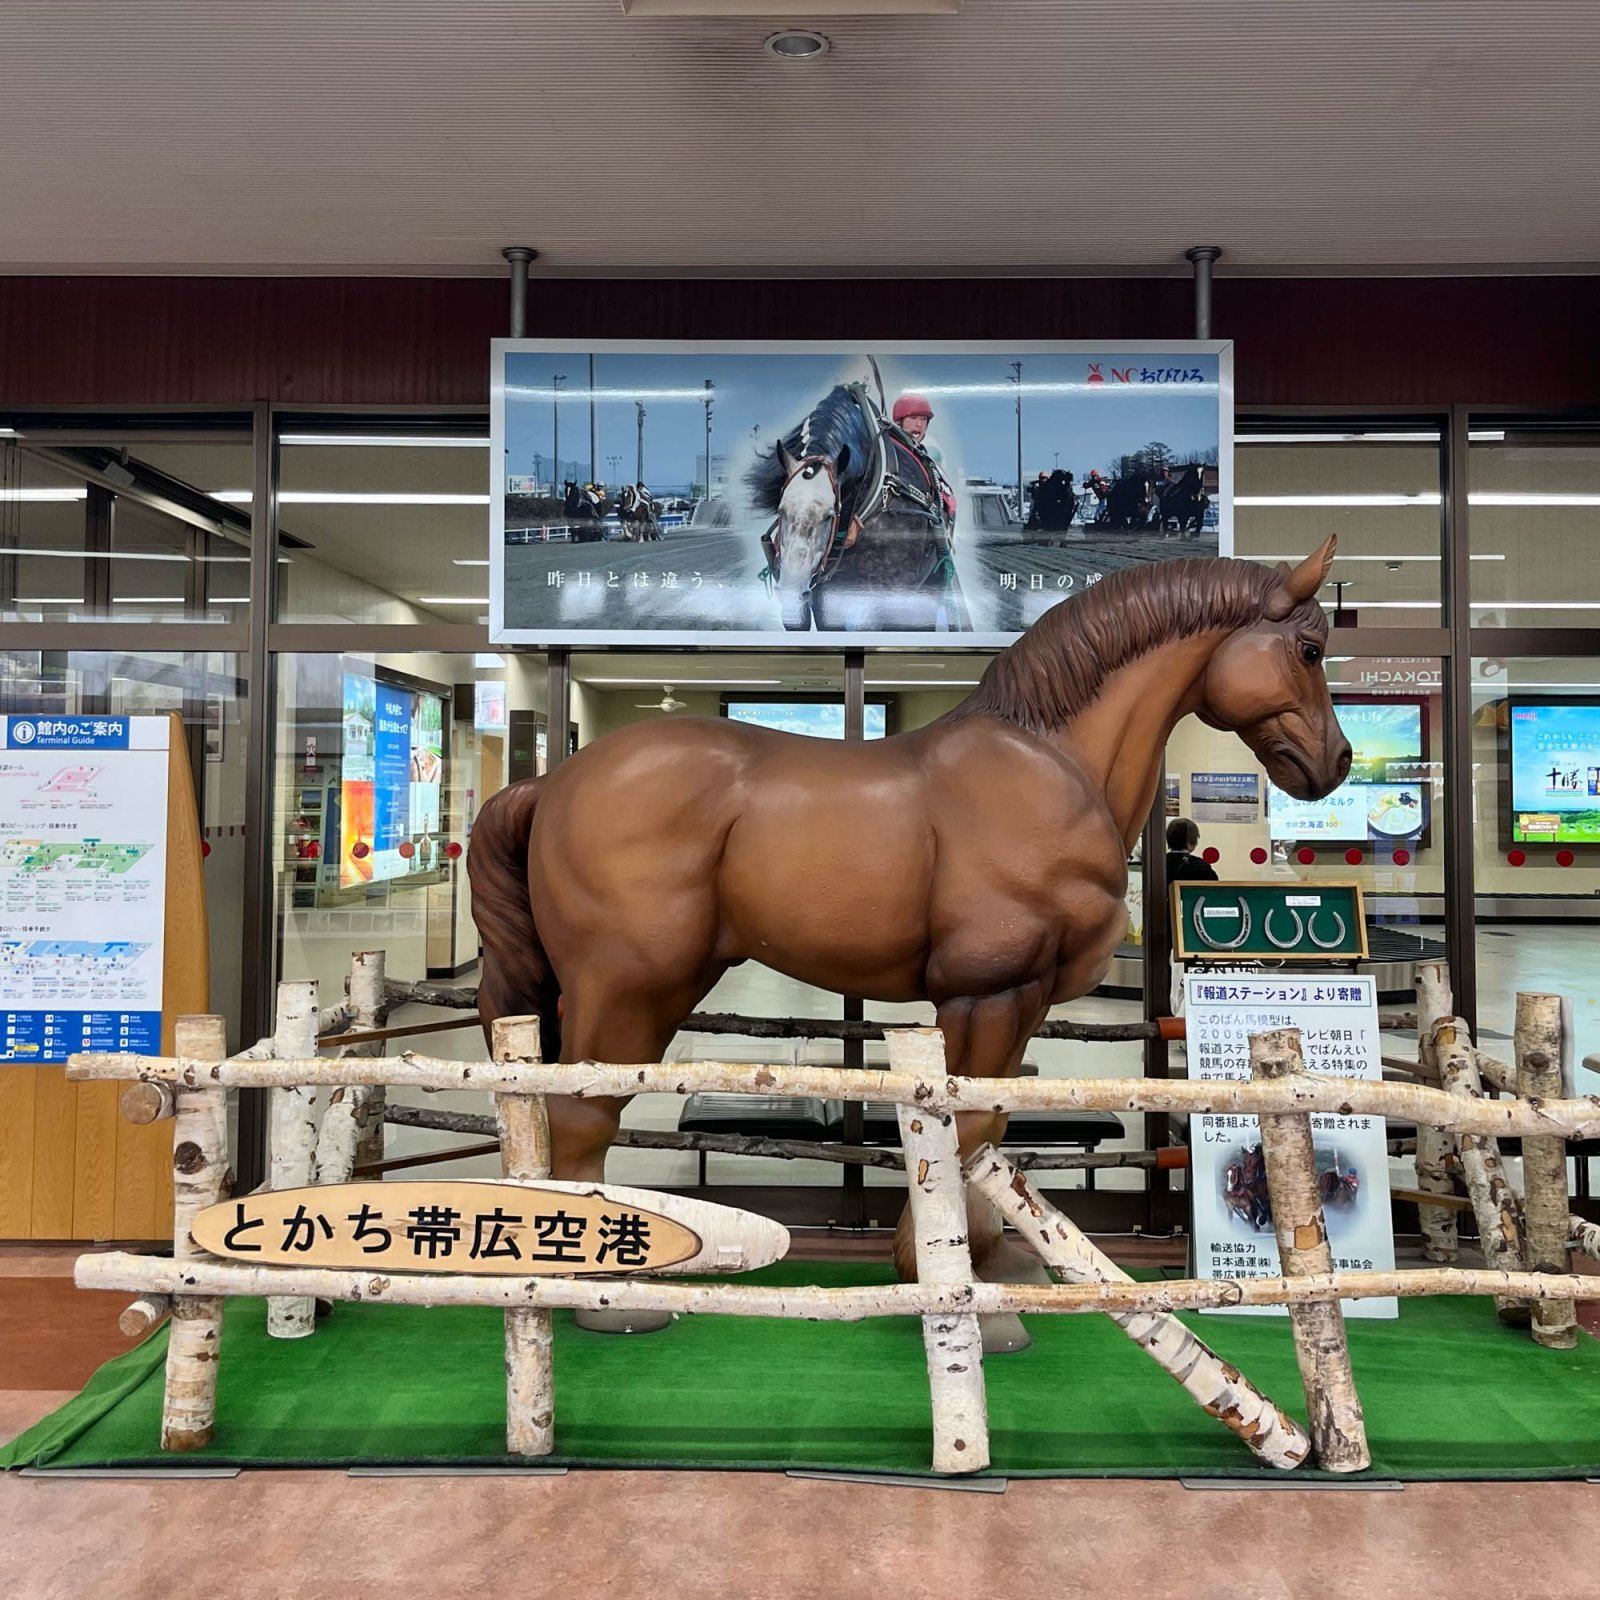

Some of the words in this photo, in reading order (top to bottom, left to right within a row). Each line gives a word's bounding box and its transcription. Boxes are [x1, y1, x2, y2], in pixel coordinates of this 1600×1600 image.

[547, 570, 724, 589] 昨日とは違う、
[1339, 714, 1359, 722] ove
[1362, 711, 1383, 722] Life
[37, 720, 123, 736] 館内のご案内
[37, 736, 70, 744] Terminal
[71, 736, 96, 745] Guide
[1545, 767, 1583, 790] 十勝
[1197, 985, 1362, 1002] 『報道ステーション』より寄贈
[1198, 1014, 1298, 1027] このばん馬模型は、
[1204, 1131, 1232, 1143] した。
[223, 1203, 652, 1266] とかち帯広空港
[1210, 1242, 1256, 1254] 輸送協力
